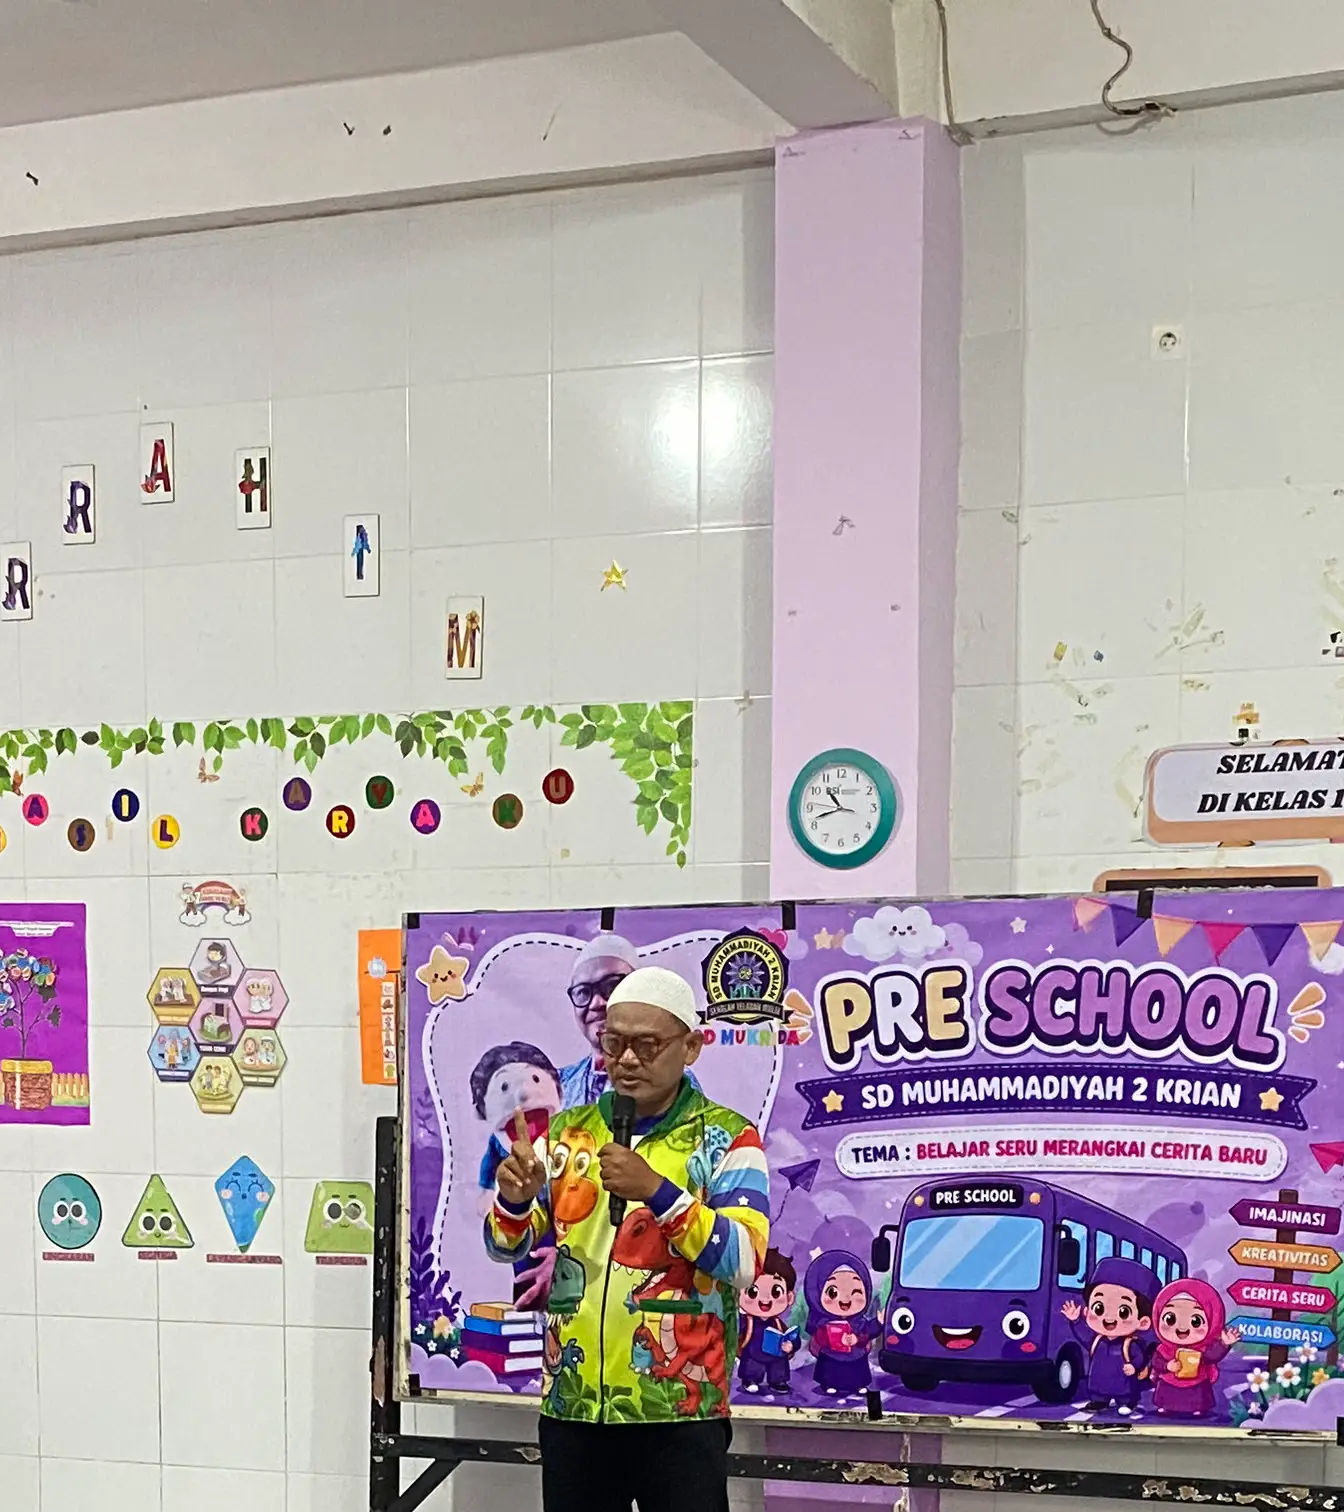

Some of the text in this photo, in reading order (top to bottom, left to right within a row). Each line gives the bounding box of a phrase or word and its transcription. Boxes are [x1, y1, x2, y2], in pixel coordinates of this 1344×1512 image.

[837, 768, 847, 779] 12
[811, 786, 821, 796] 10
[866, 786, 873, 796] 2
[870, 803, 877, 813] 3
[1196, 792, 1233, 815] DI
[1235, 788, 1328, 813] KELAS
[822, 833, 830, 843] 7
[837, 837, 845, 847] 6
[853, 833, 861, 843] 5
[819, 964, 1281, 1067] PRE SCHOOL
[861, 1076, 1241, 1110] SD MUHAMMADIYAH 2 KRIAN
[852, 1145, 900, 1164] TEMA
[917, 1139, 992, 1161] BELAJAR
[995, 1139, 1039, 1159] SERU
[1043, 1139, 1146, 1159] MERANGKAI
[1151, 1141, 1214, 1163] CERITA
[1218, 1144, 1268, 1166] BARU
[935, 1188, 1017, 1204] PRE SCHOOL
[1249, 1207, 1326, 1227] IMAJINASI
[1242, 1246, 1328, 1267] KREATIVITAS
[1241, 1285, 1326, 1308] CERITA SERU
[1239, 1323, 1323, 1343] KOLABORASI
